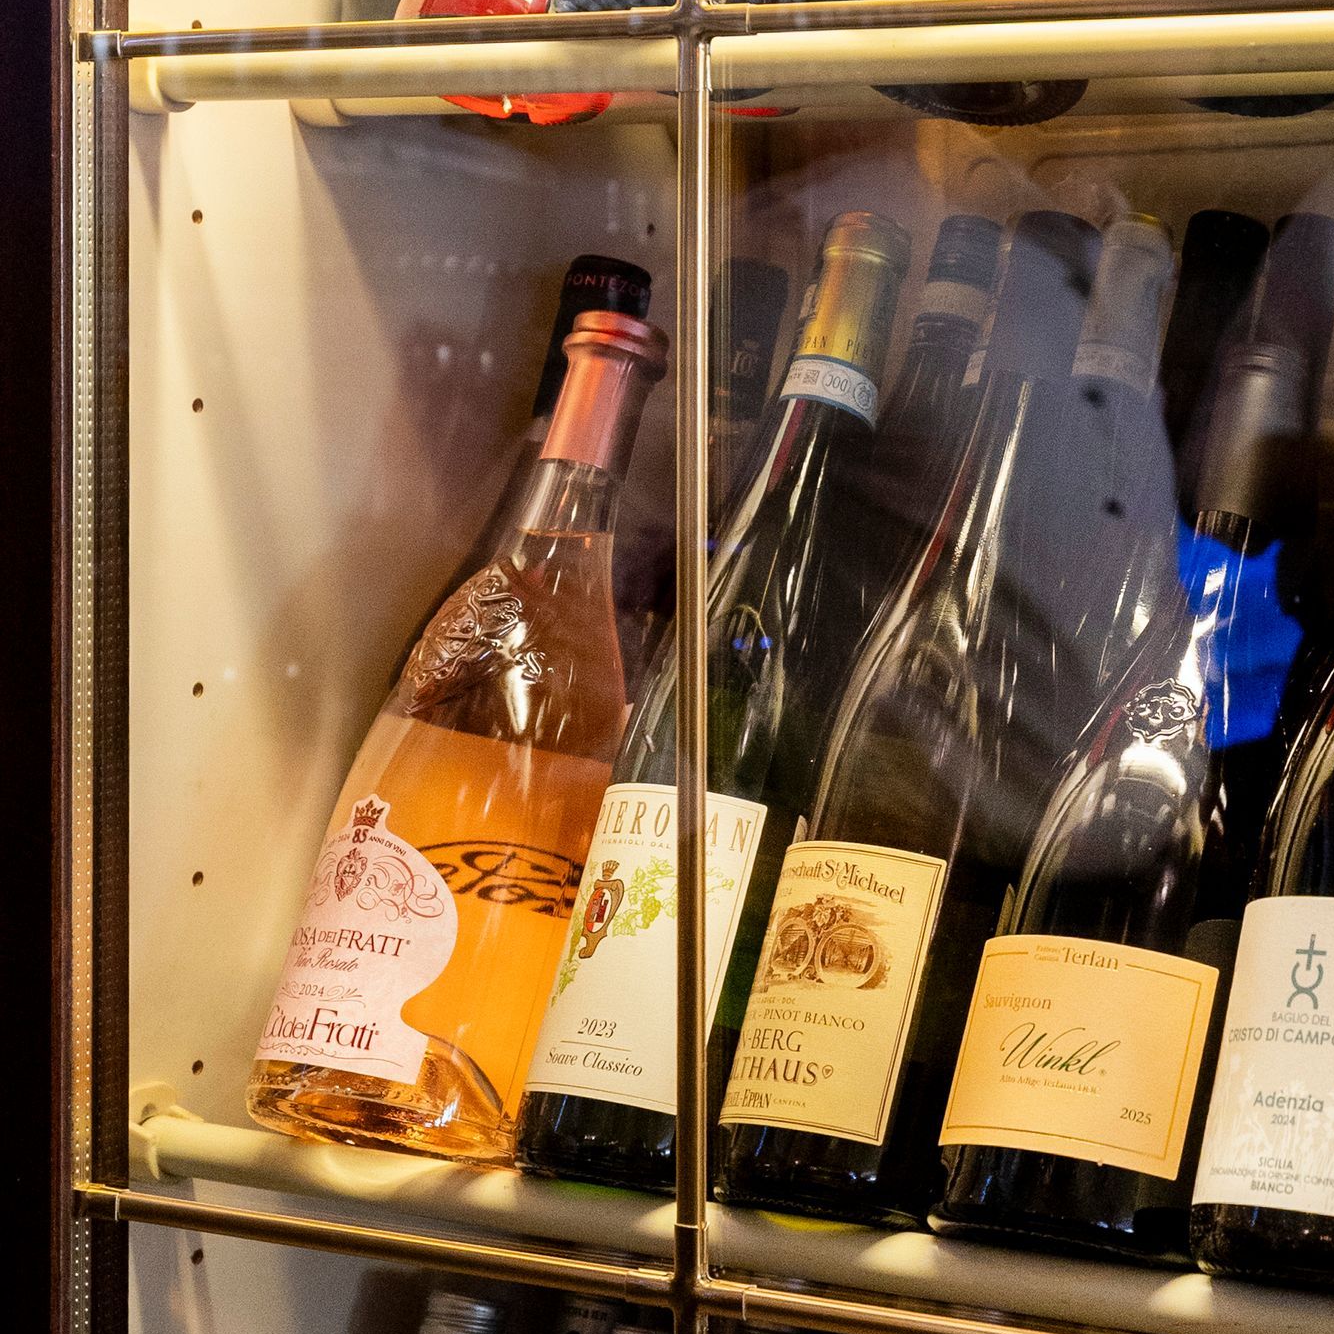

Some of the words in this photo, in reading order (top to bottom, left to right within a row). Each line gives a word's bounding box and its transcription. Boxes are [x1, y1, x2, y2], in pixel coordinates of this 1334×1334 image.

[352, 828, 369, 844] 85
[369, 835, 385, 845] ANNI
[384, 840, 394, 848] DI
[594, 800, 752, 855] PIEROAN
[601, 838, 646, 848] VIGNAIOLI
[650, 841, 672, 850] DAL
[836, 860, 906, 905] Michael
[318, 930, 338, 944] DEI
[336, 928, 406, 958] FRATI
[311, 947, 360, 973] Rosato
[1062, 946, 1120, 971] Terlan
[298, 983, 326, 997] 2024
[983, 993, 1052, 1012] Sauvignon
[307, 1007, 377, 1051] Frati
[577, 1017, 618, 1040] 2023
[763, 1008, 801, 1022] PINOT
[804, 1011, 866, 1032] BIANCO
[1272, 1012, 1311, 1025] BAGLIO
[1312, 1014, 1332, 1027] DEL
[1228, 1027, 1263, 1043] CRISTO
[1265, 1028, 1279, 1042] DI
[1000, 1022, 1122, 1076] Winkl
[545, 1046, 579, 1067] Soave
[582, 1050, 644, 1078] Classico
[1120, 1107, 1153, 1125] 2025
[1271, 1114, 1296, 1126] 2024
[1258, 1157, 1294, 1170] SICILIA
[1250, 1180, 1295, 1196] BIANCO
